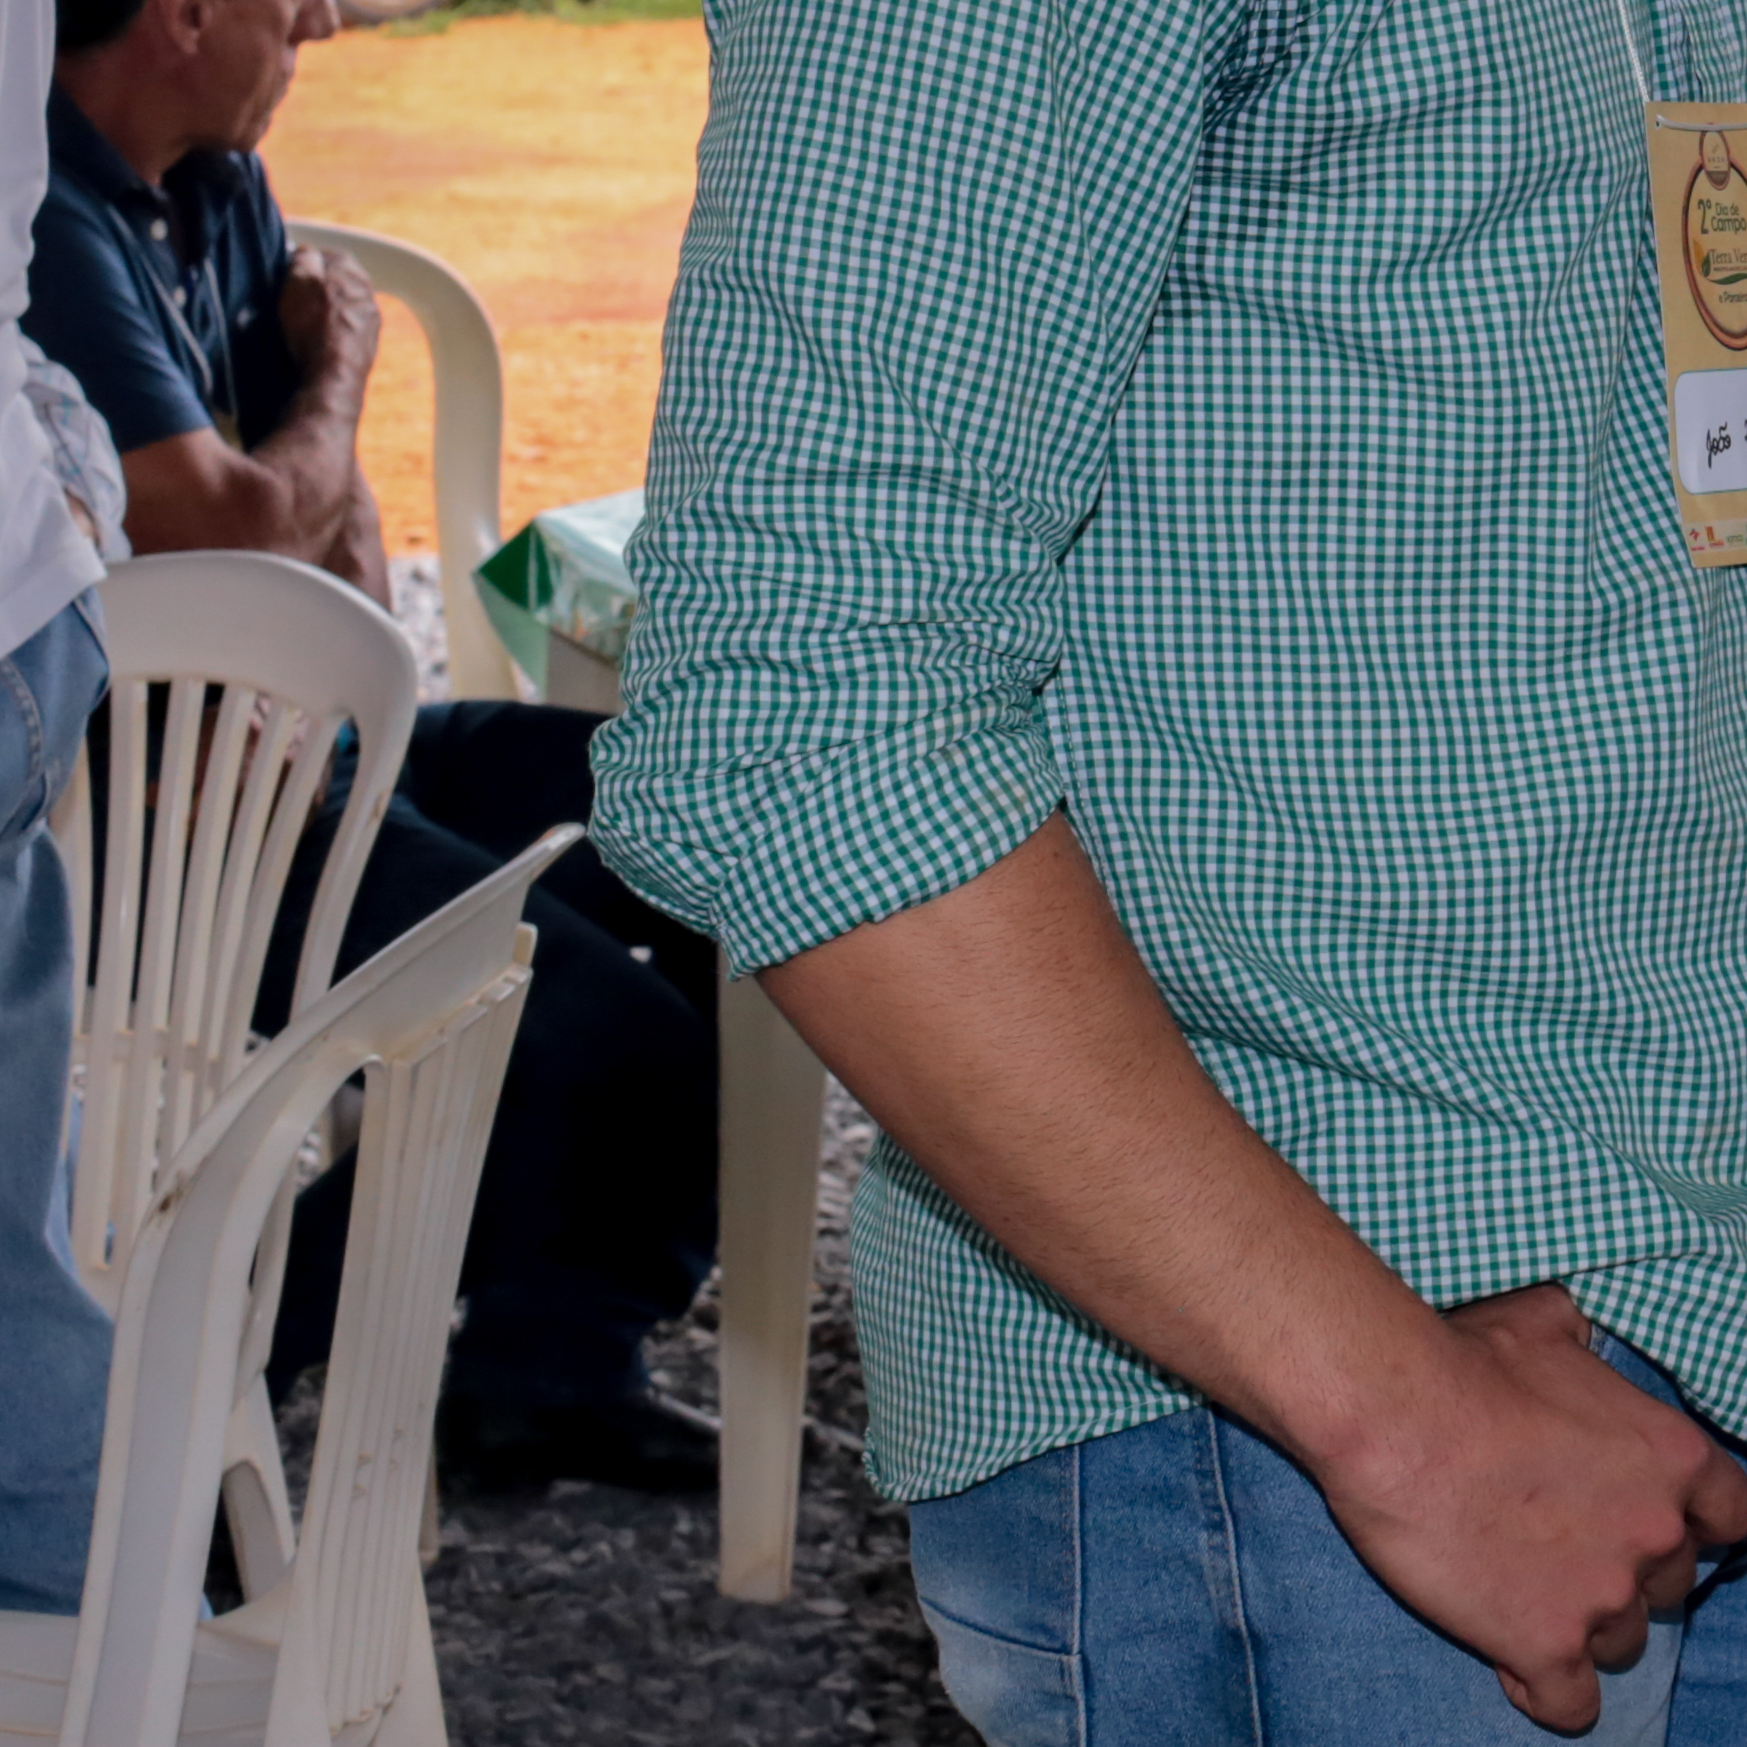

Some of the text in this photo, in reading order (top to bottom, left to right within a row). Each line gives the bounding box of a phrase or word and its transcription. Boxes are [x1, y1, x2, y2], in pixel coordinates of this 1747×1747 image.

[1715, 202, 1729, 216] Dia
[1730, 203, 1740, 216] de
[1709, 249, 1733, 265] Terra
[1706, 421, 1731, 469] João
